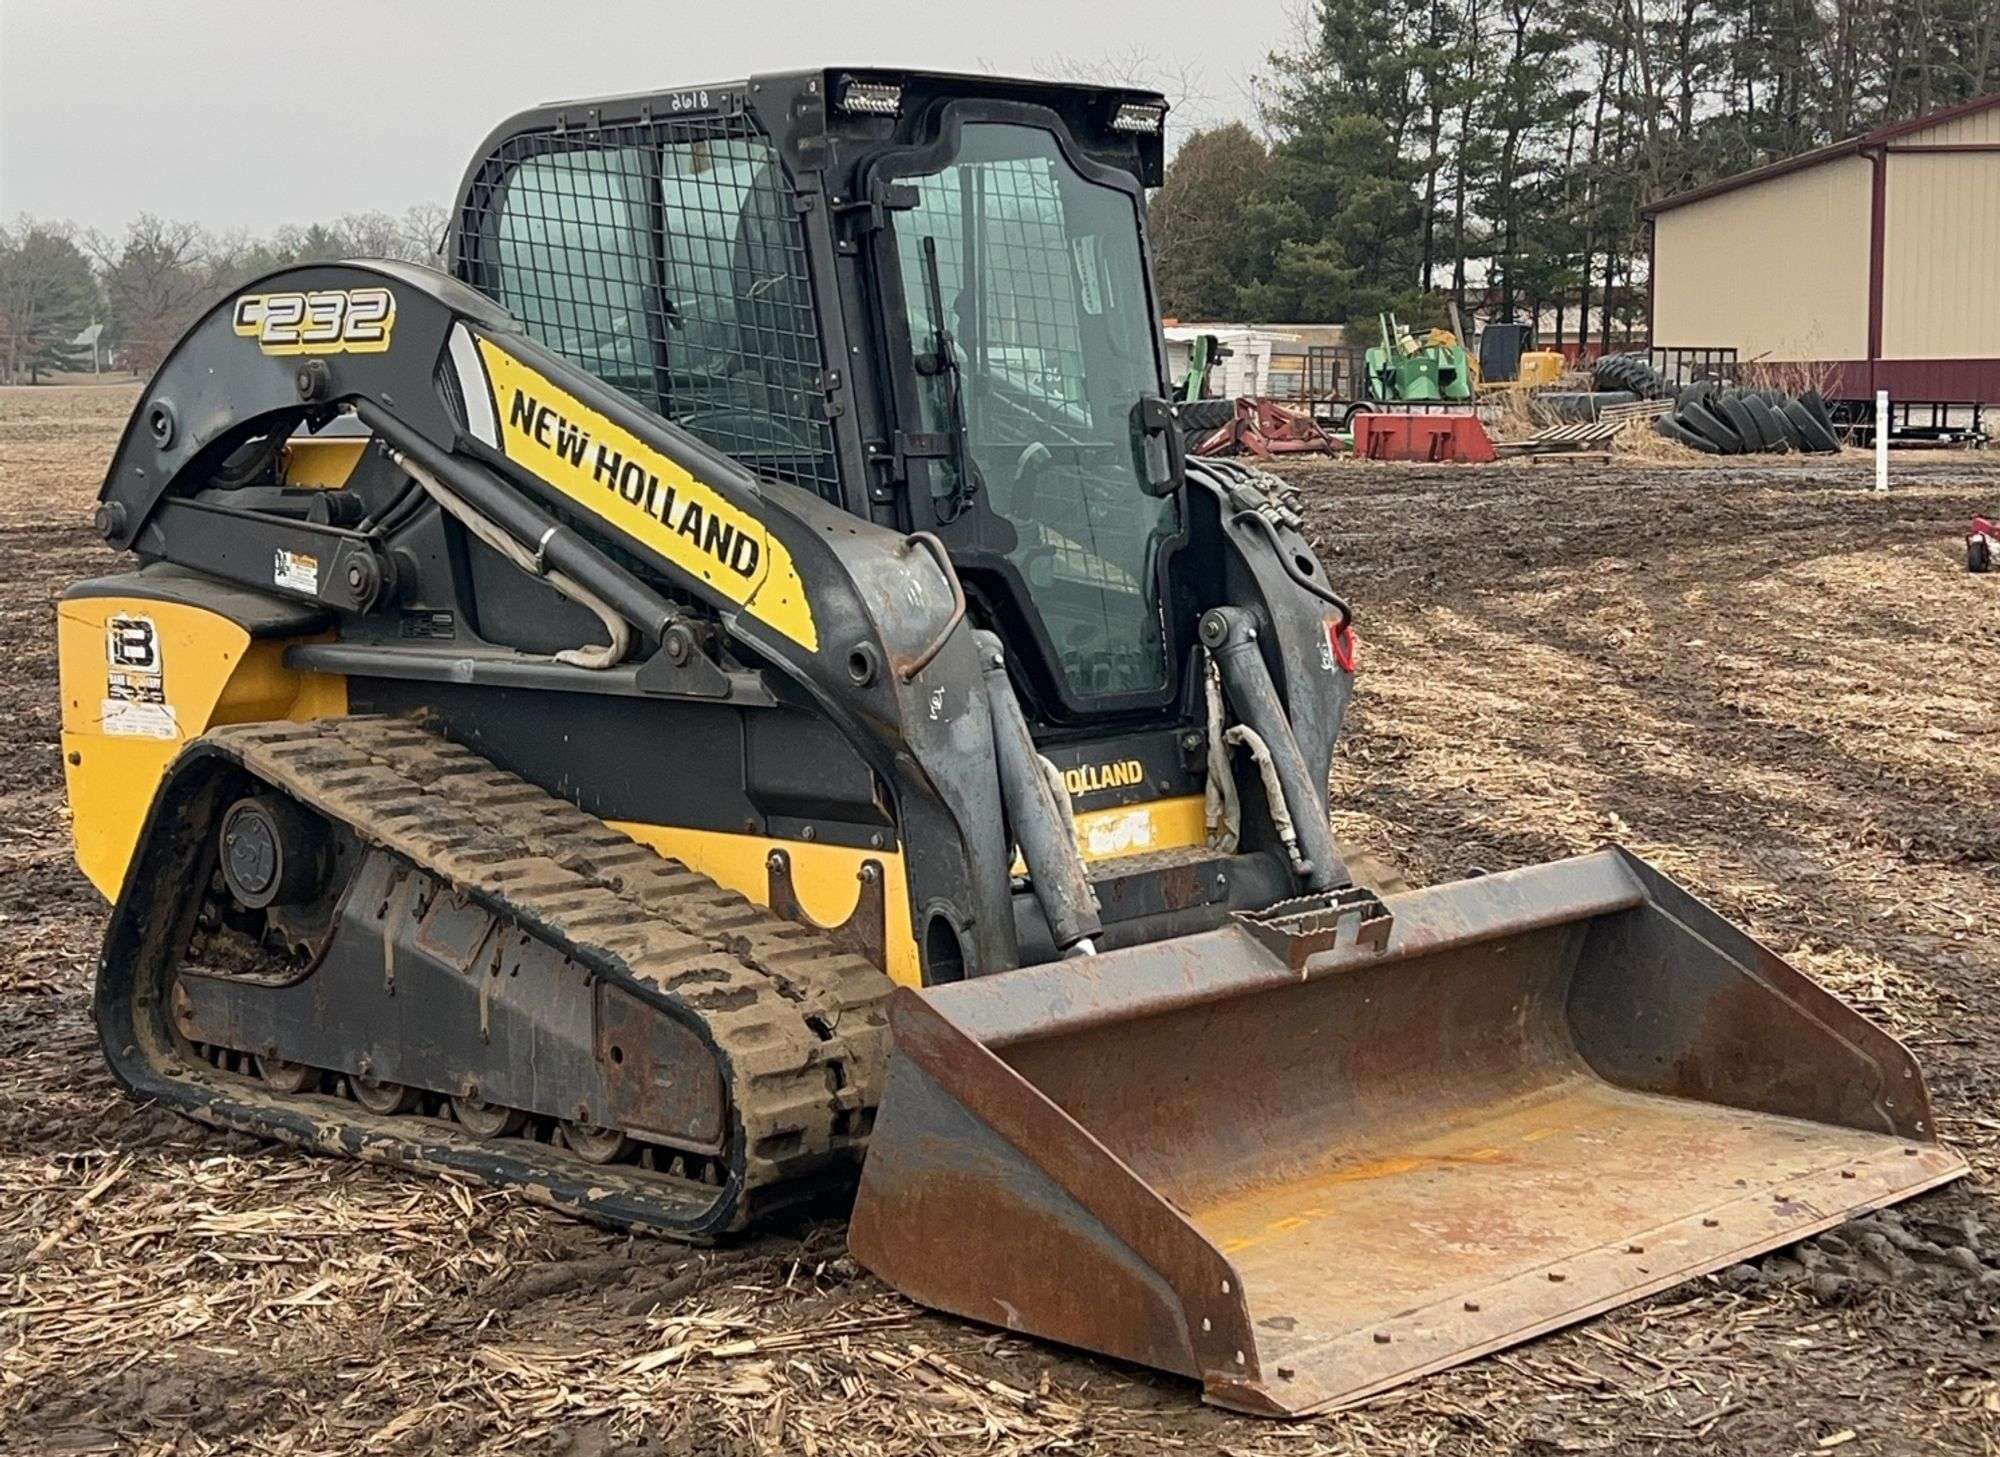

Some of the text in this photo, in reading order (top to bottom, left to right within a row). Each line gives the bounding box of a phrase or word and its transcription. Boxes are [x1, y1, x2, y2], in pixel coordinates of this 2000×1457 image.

[671, 91, 709, 110] 2618
[233, 288, 395, 354] C232
[509, 388, 759, 579] NEW HOLLAND
